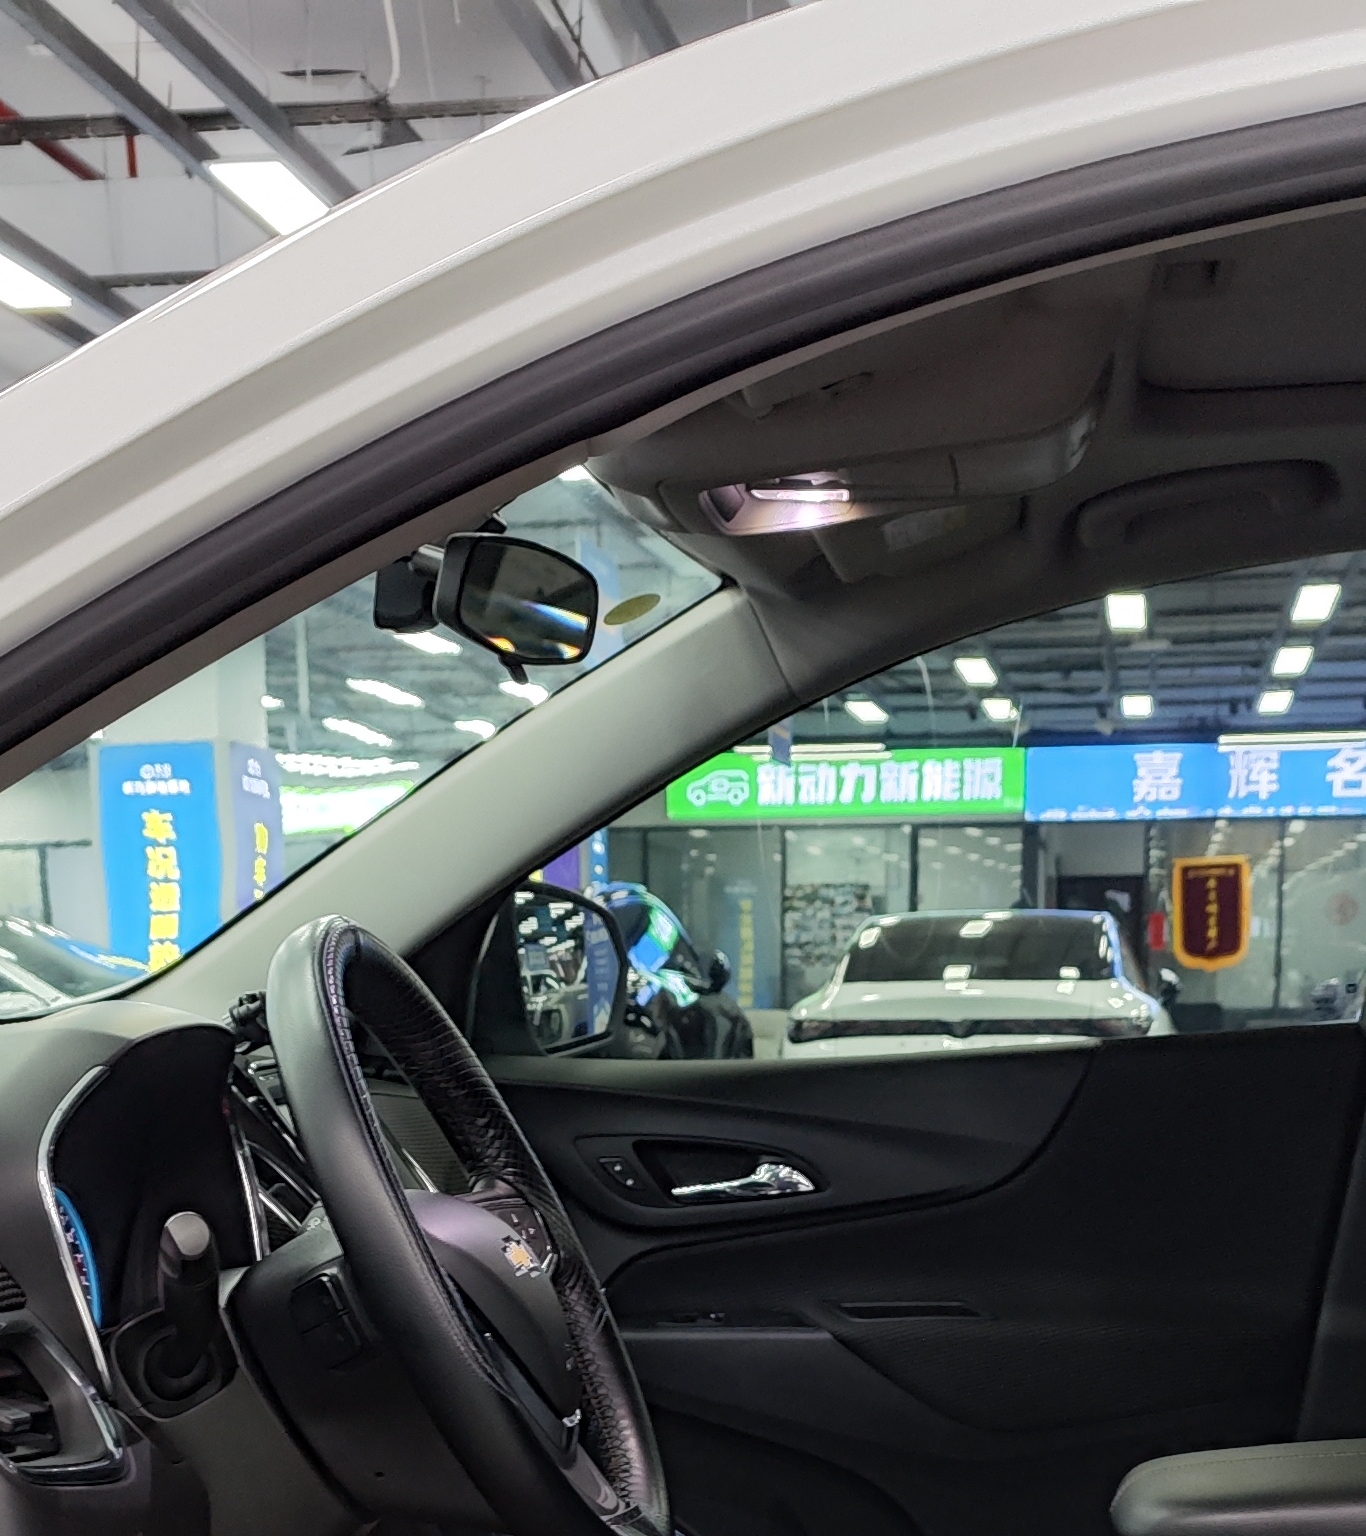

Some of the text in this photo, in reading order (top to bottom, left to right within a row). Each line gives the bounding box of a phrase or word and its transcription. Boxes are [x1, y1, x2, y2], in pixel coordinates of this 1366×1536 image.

[756, 757, 1003, 806] 新动力新能源
